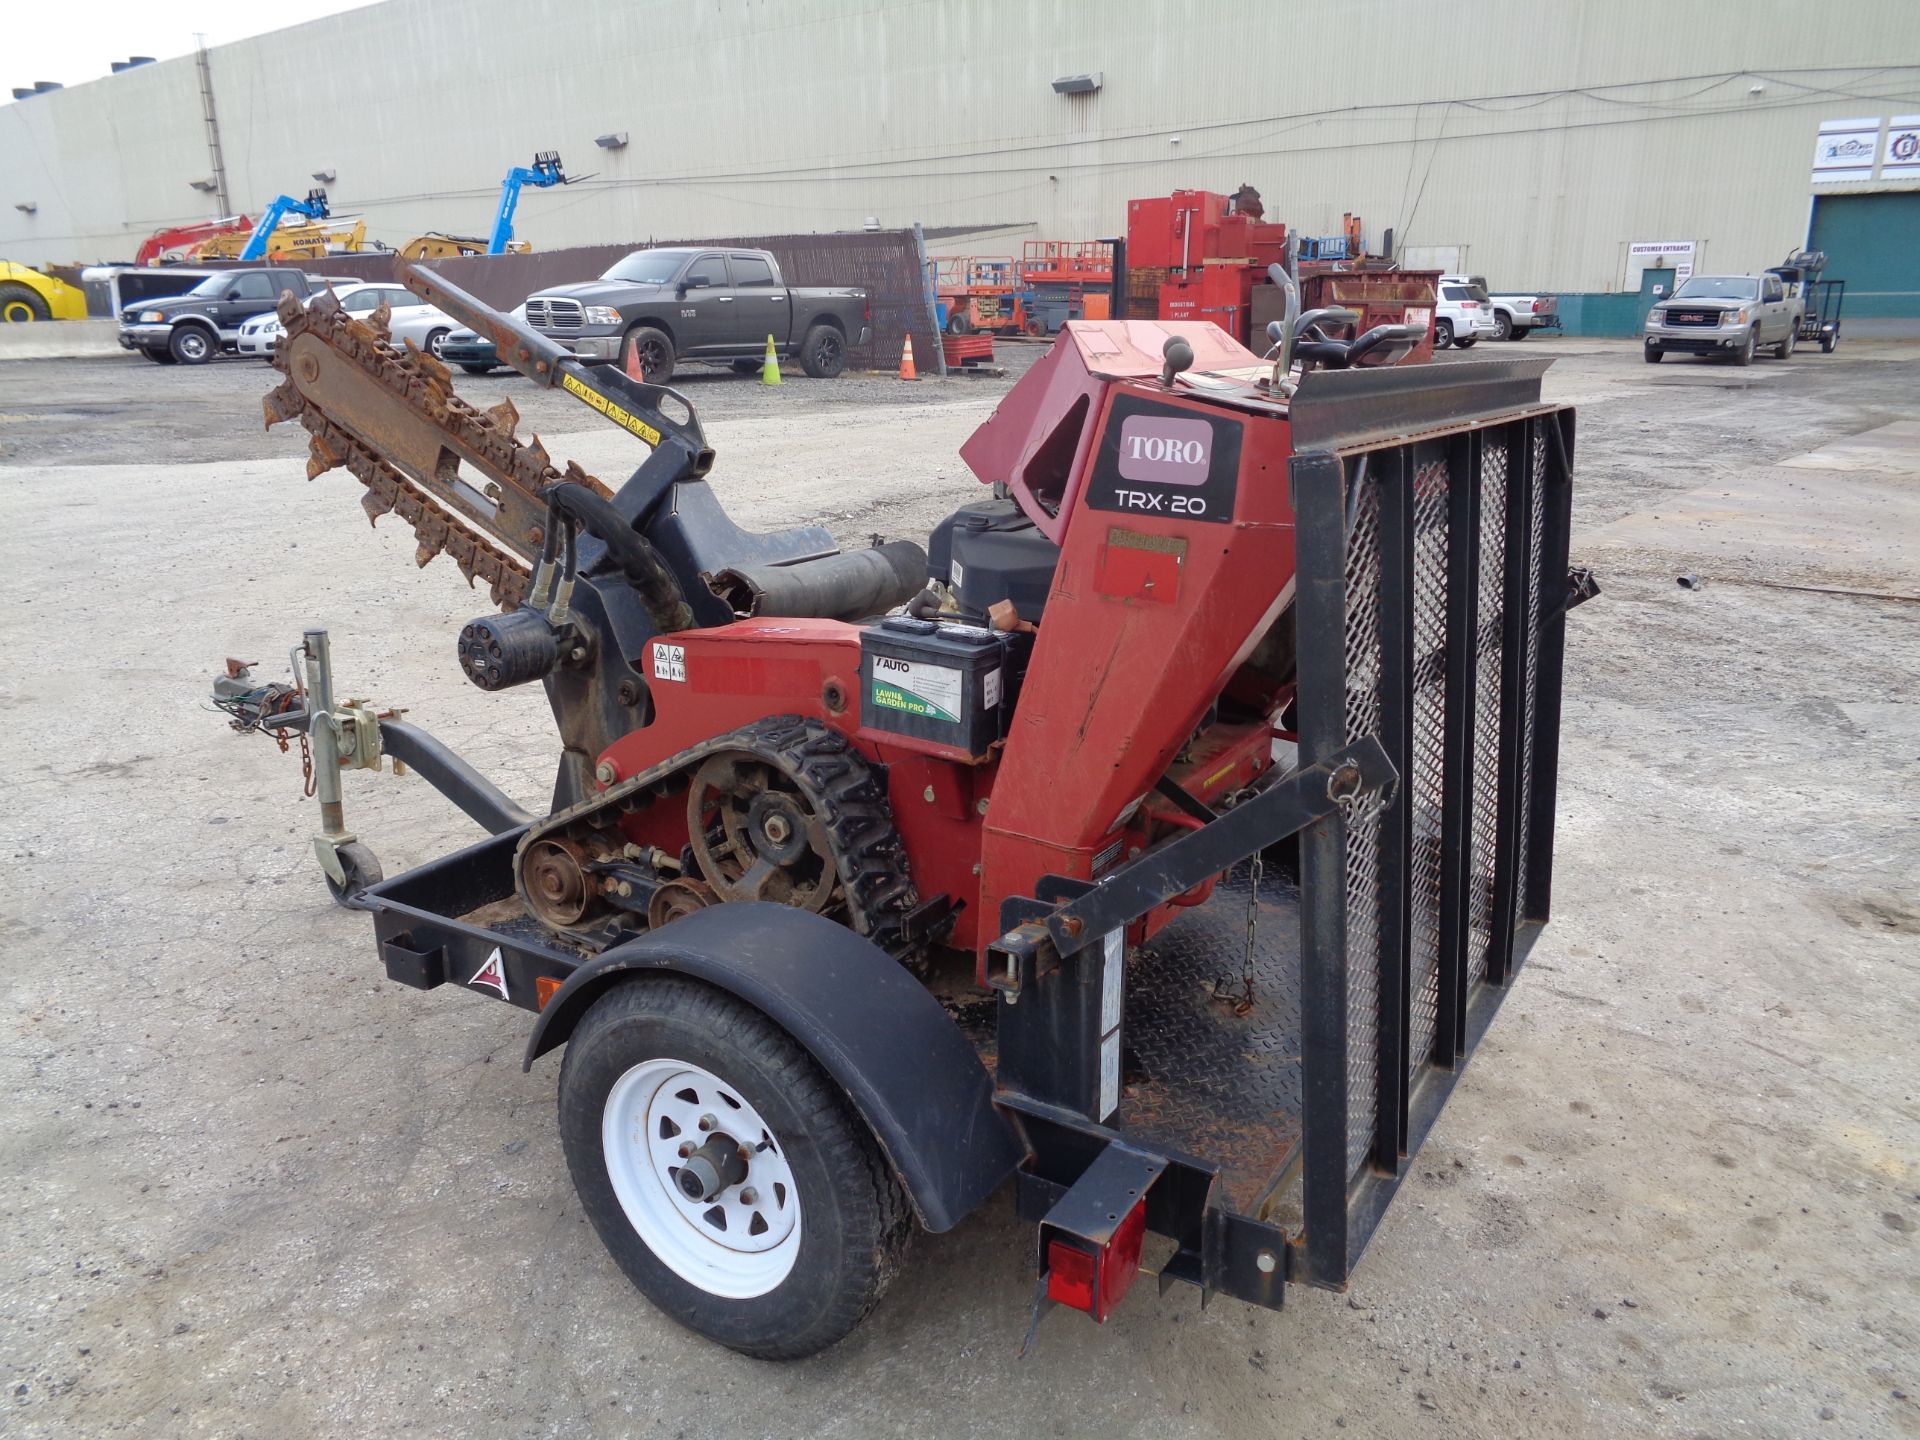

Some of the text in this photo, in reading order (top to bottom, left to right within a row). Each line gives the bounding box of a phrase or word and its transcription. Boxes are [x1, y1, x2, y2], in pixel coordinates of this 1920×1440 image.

[293, 236, 331, 246] KOMATSU
[1632, 244, 1691, 253] CUSTOMER ENTRANCE
[1679, 314, 1704, 322] GMC
[1128, 436, 1204, 465] TORO
[882, 659, 909, 673] AUTO
[875, 697, 925, 713] GARDEN PRO
